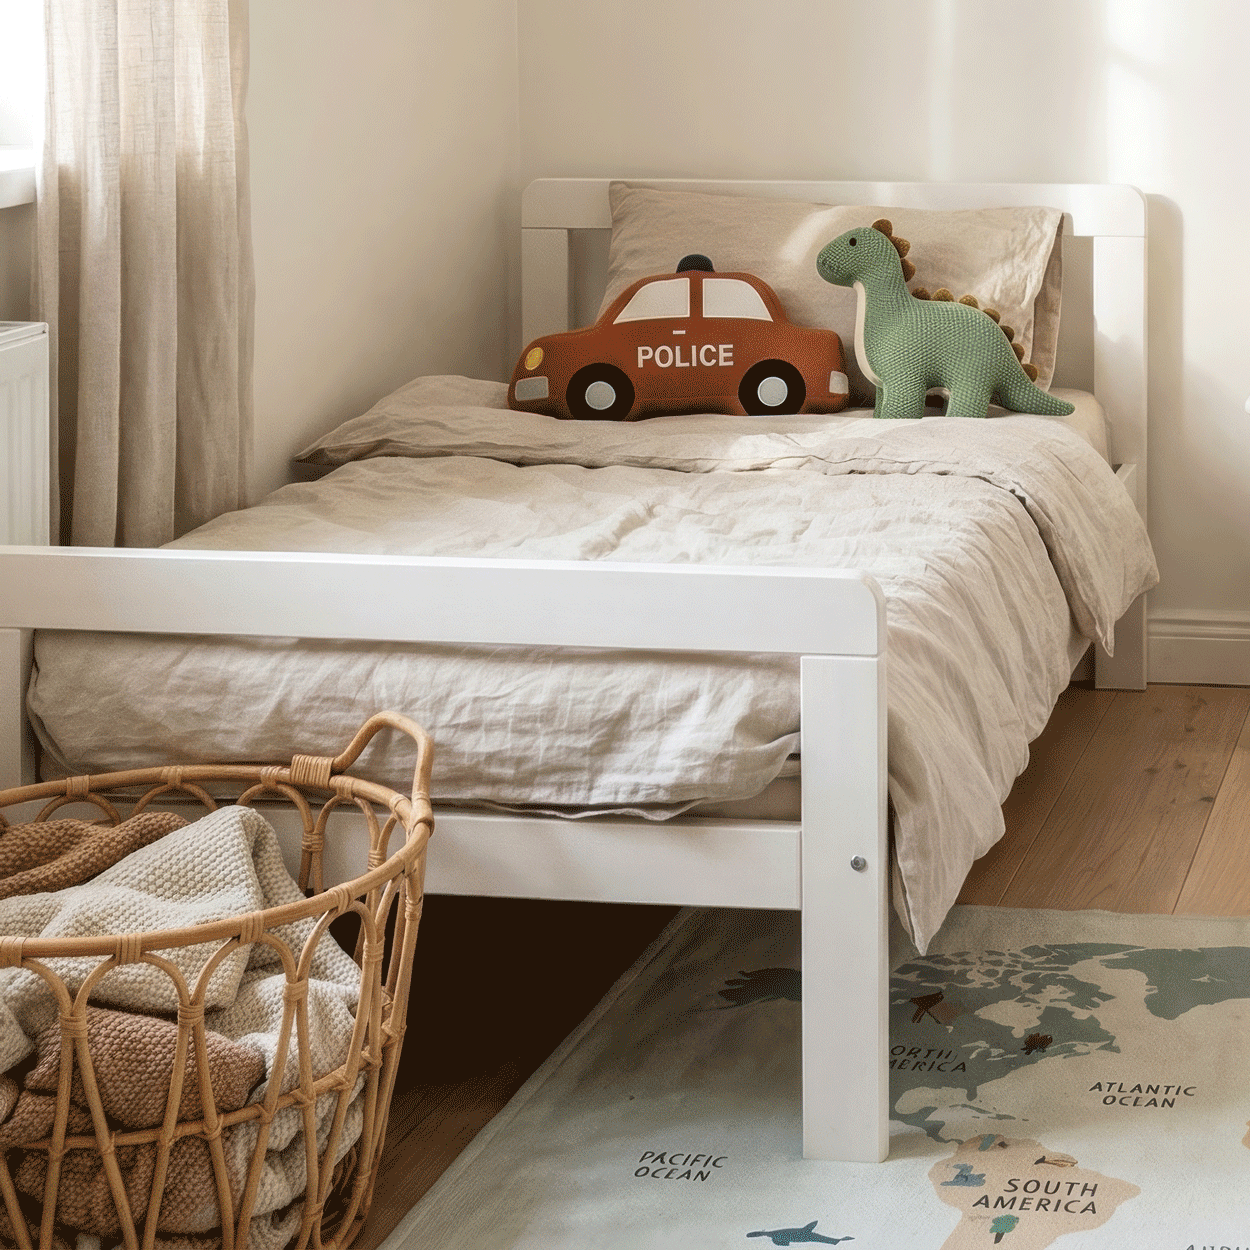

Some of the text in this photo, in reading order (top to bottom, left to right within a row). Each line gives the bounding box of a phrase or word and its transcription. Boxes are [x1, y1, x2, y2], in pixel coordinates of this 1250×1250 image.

[637, 344, 734, 368] POLICE
[889, 1057, 967, 1073] ERICA
[1088, 1081, 1197, 1097] ATLANTIC
[1102, 1095, 1176, 1109] OCEAN
[638, 1150, 729, 1169] PACIFIC
[634, 1166, 711, 1182] OCEAN
[1003, 1178, 1099, 1198] SOUTH
[972, 1194, 1098, 1215] AMERICA
